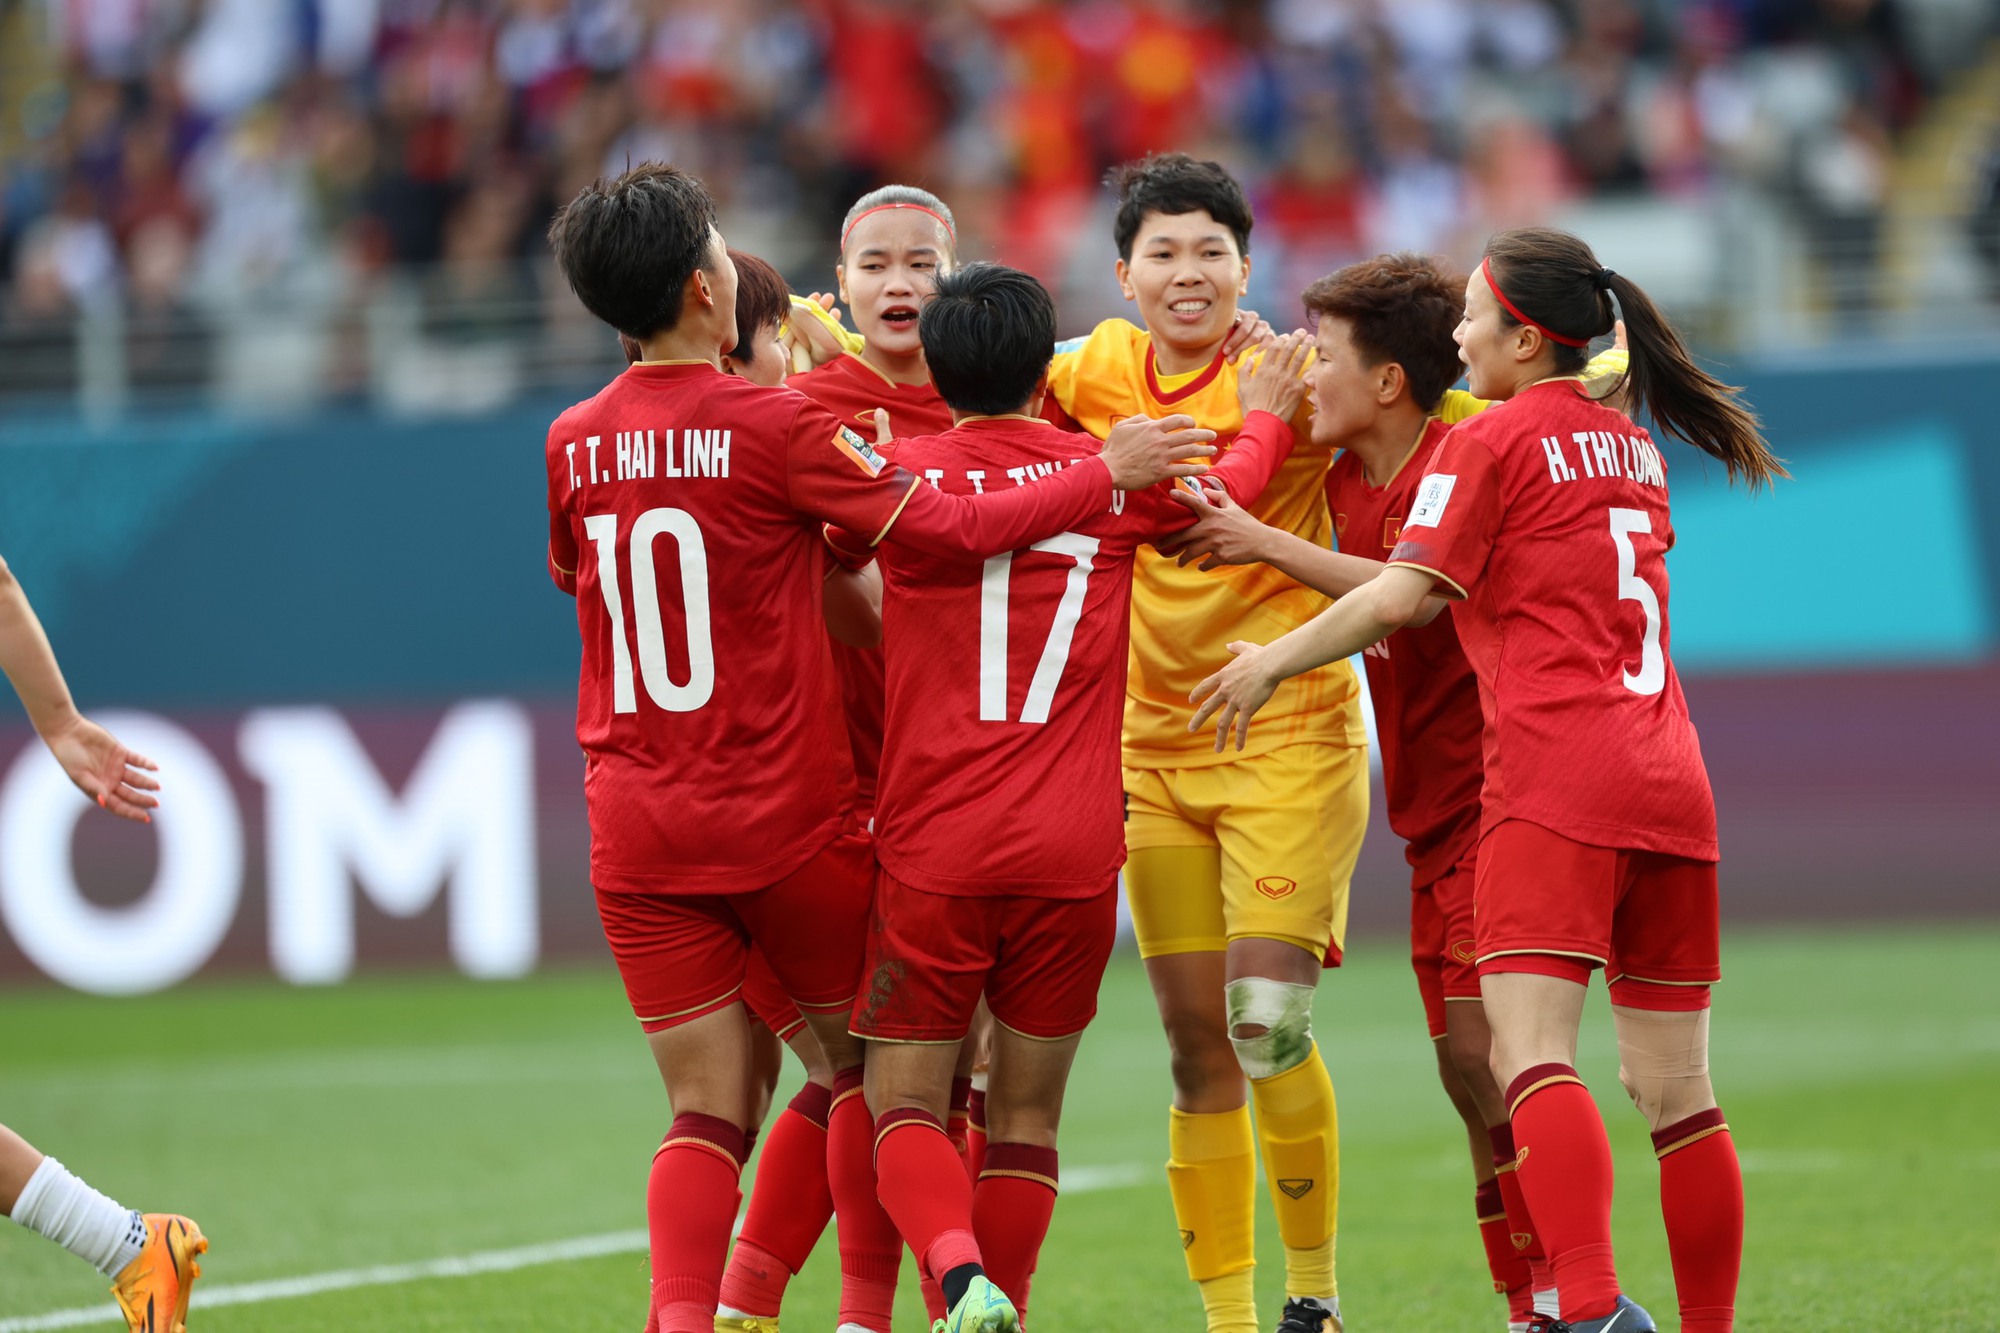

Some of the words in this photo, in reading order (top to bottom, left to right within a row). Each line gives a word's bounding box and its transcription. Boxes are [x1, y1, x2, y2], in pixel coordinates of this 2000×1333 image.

[565, 442, 582, 492] T.
[586, 435, 610, 485] T.
[616, 430, 656, 481] HAI
[666, 429, 732, 478] LINH
[1540, 436, 1577, 484] H.
[1572, 431, 1622, 479] THI
[1617, 433, 1665, 489] LOAN
[583, 507, 715, 714] 10
[979, 531, 1101, 724] 17
[1609, 507, 1665, 696] 5
[0, 698, 542, 998] OM
